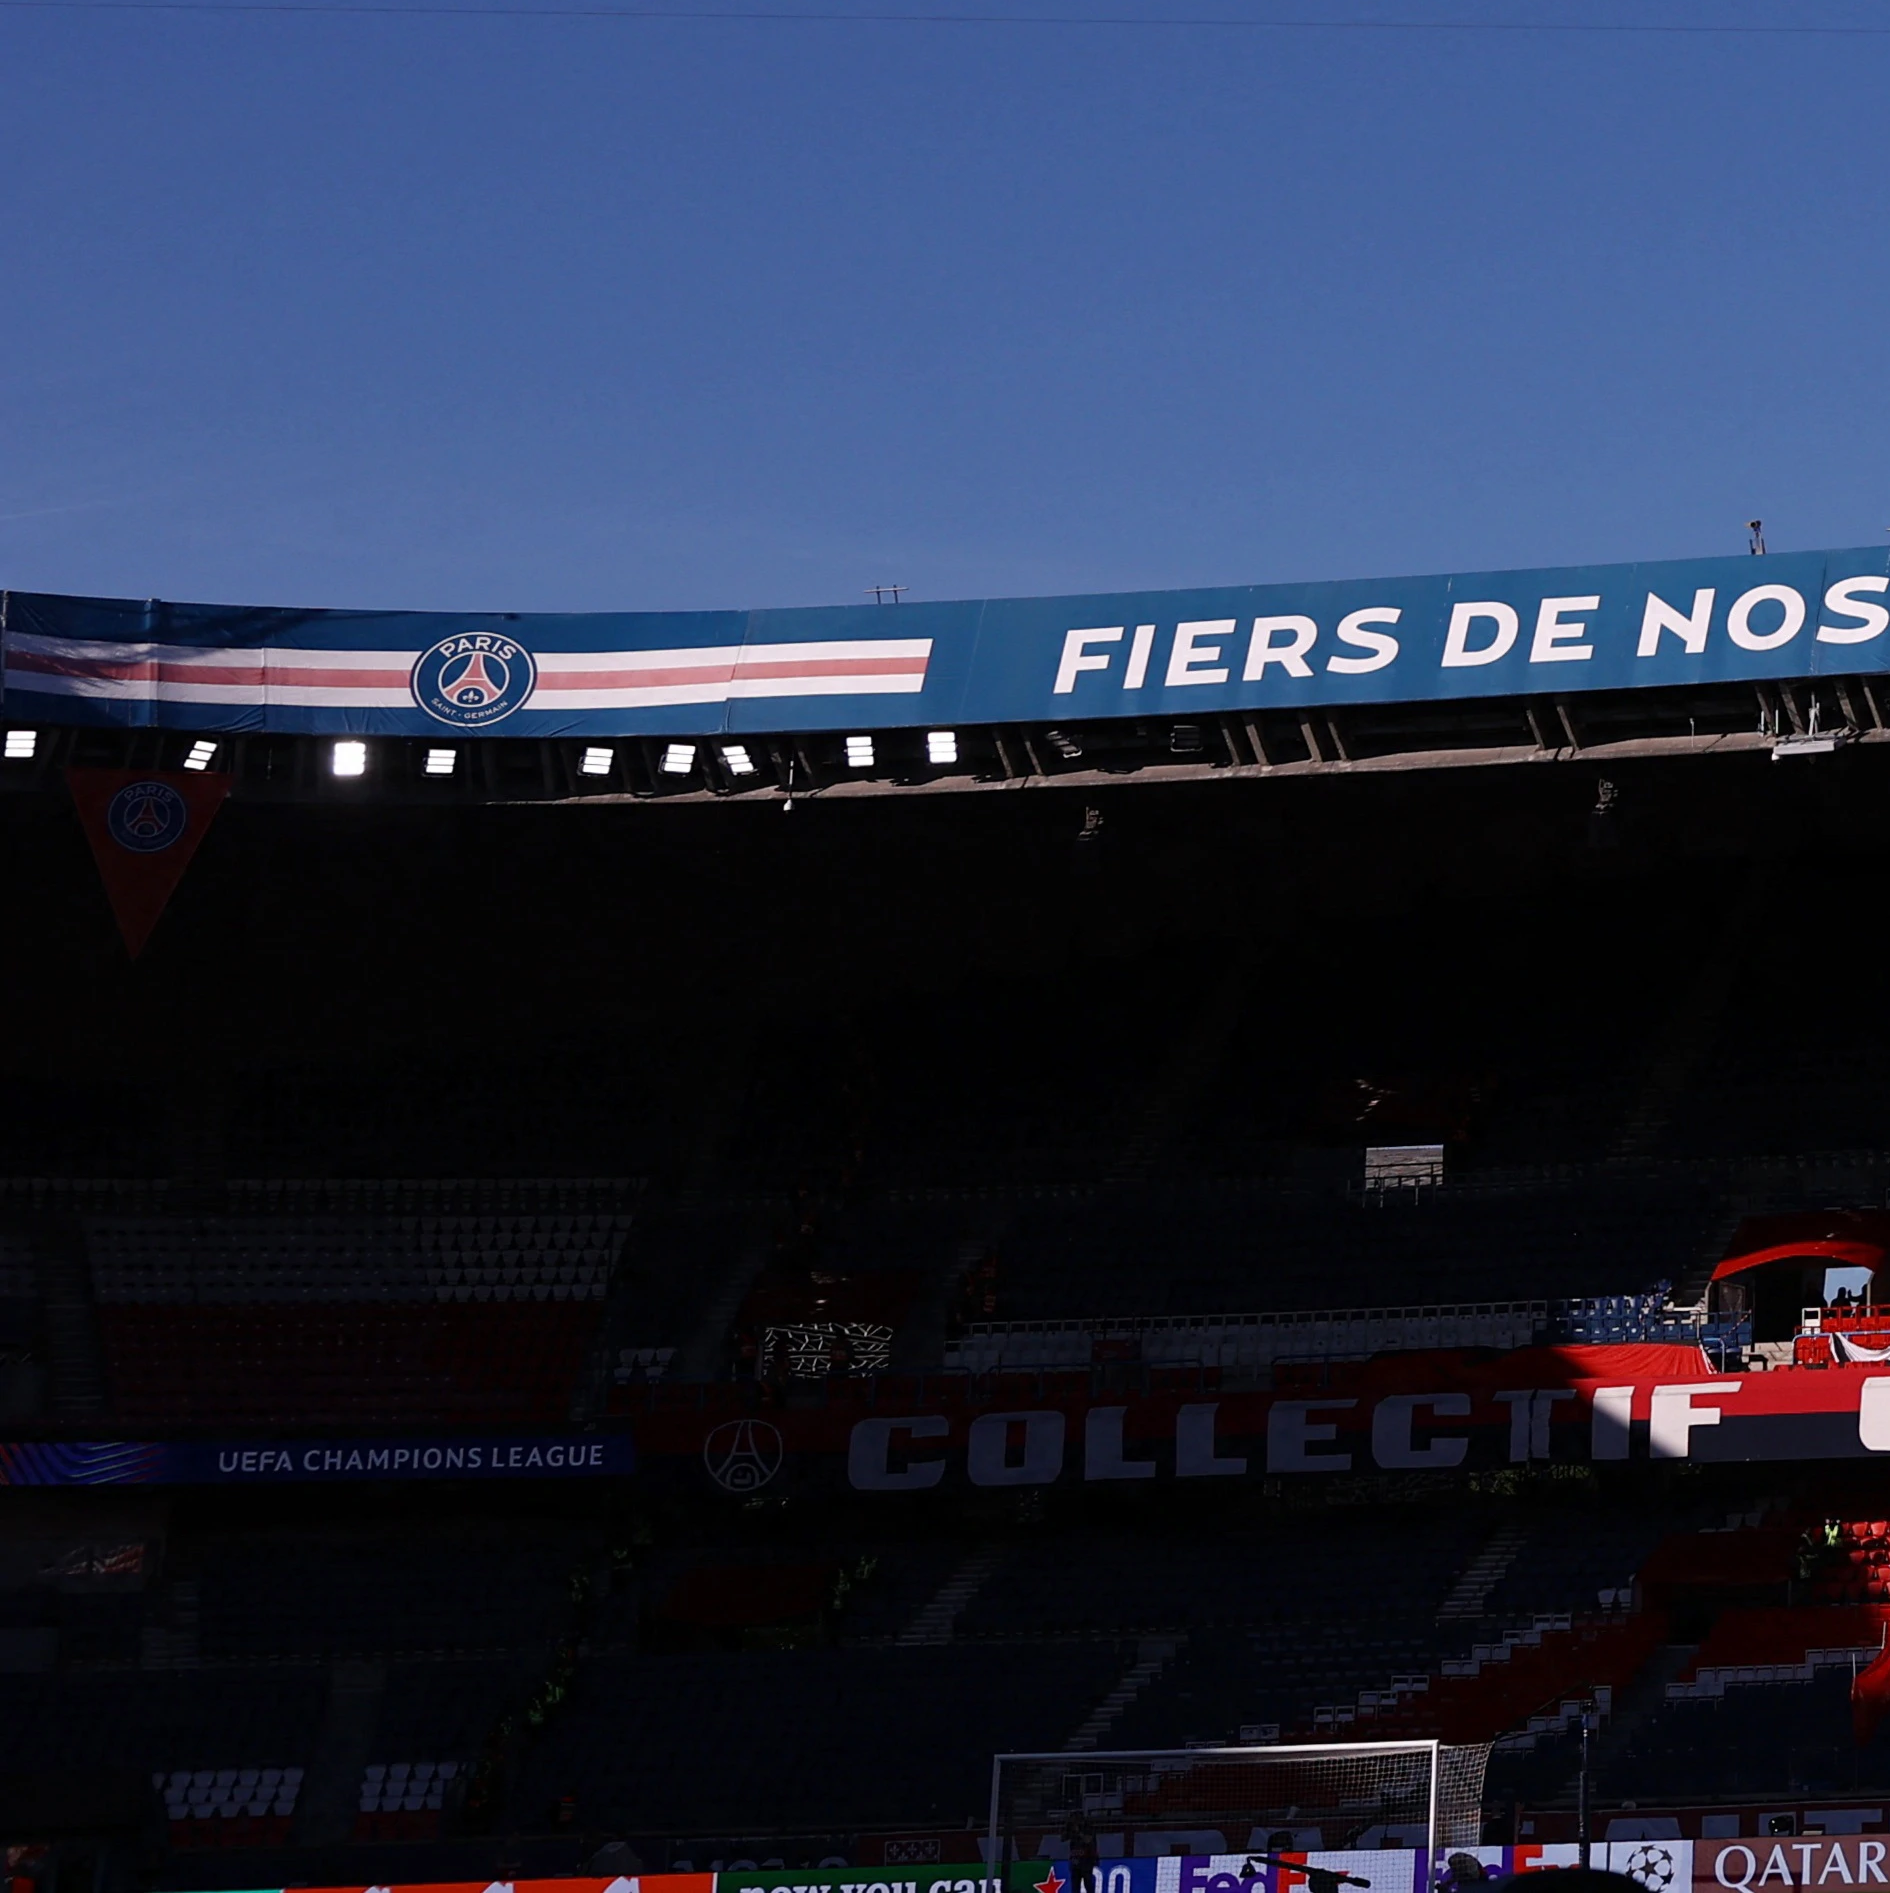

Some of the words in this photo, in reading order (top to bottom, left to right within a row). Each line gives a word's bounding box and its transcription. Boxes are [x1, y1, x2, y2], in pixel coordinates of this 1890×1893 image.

[438, 636, 517, 660] PARIS
[1053, 607, 1402, 694] FIERS
[1441, 595, 1600, 667] DE
[1636, 576, 1890, 657] NOS
[124, 786, 175, 803] PARIS
[847, 1380, 1742, 1492] COLLECTIF
[216, 1449, 294, 1474] UEFA
[302, 1445, 483, 1473] CHAMPIONS
[491, 1443, 604, 1469] LEAGUE
[1714, 1841, 1890, 1893] QATAR
